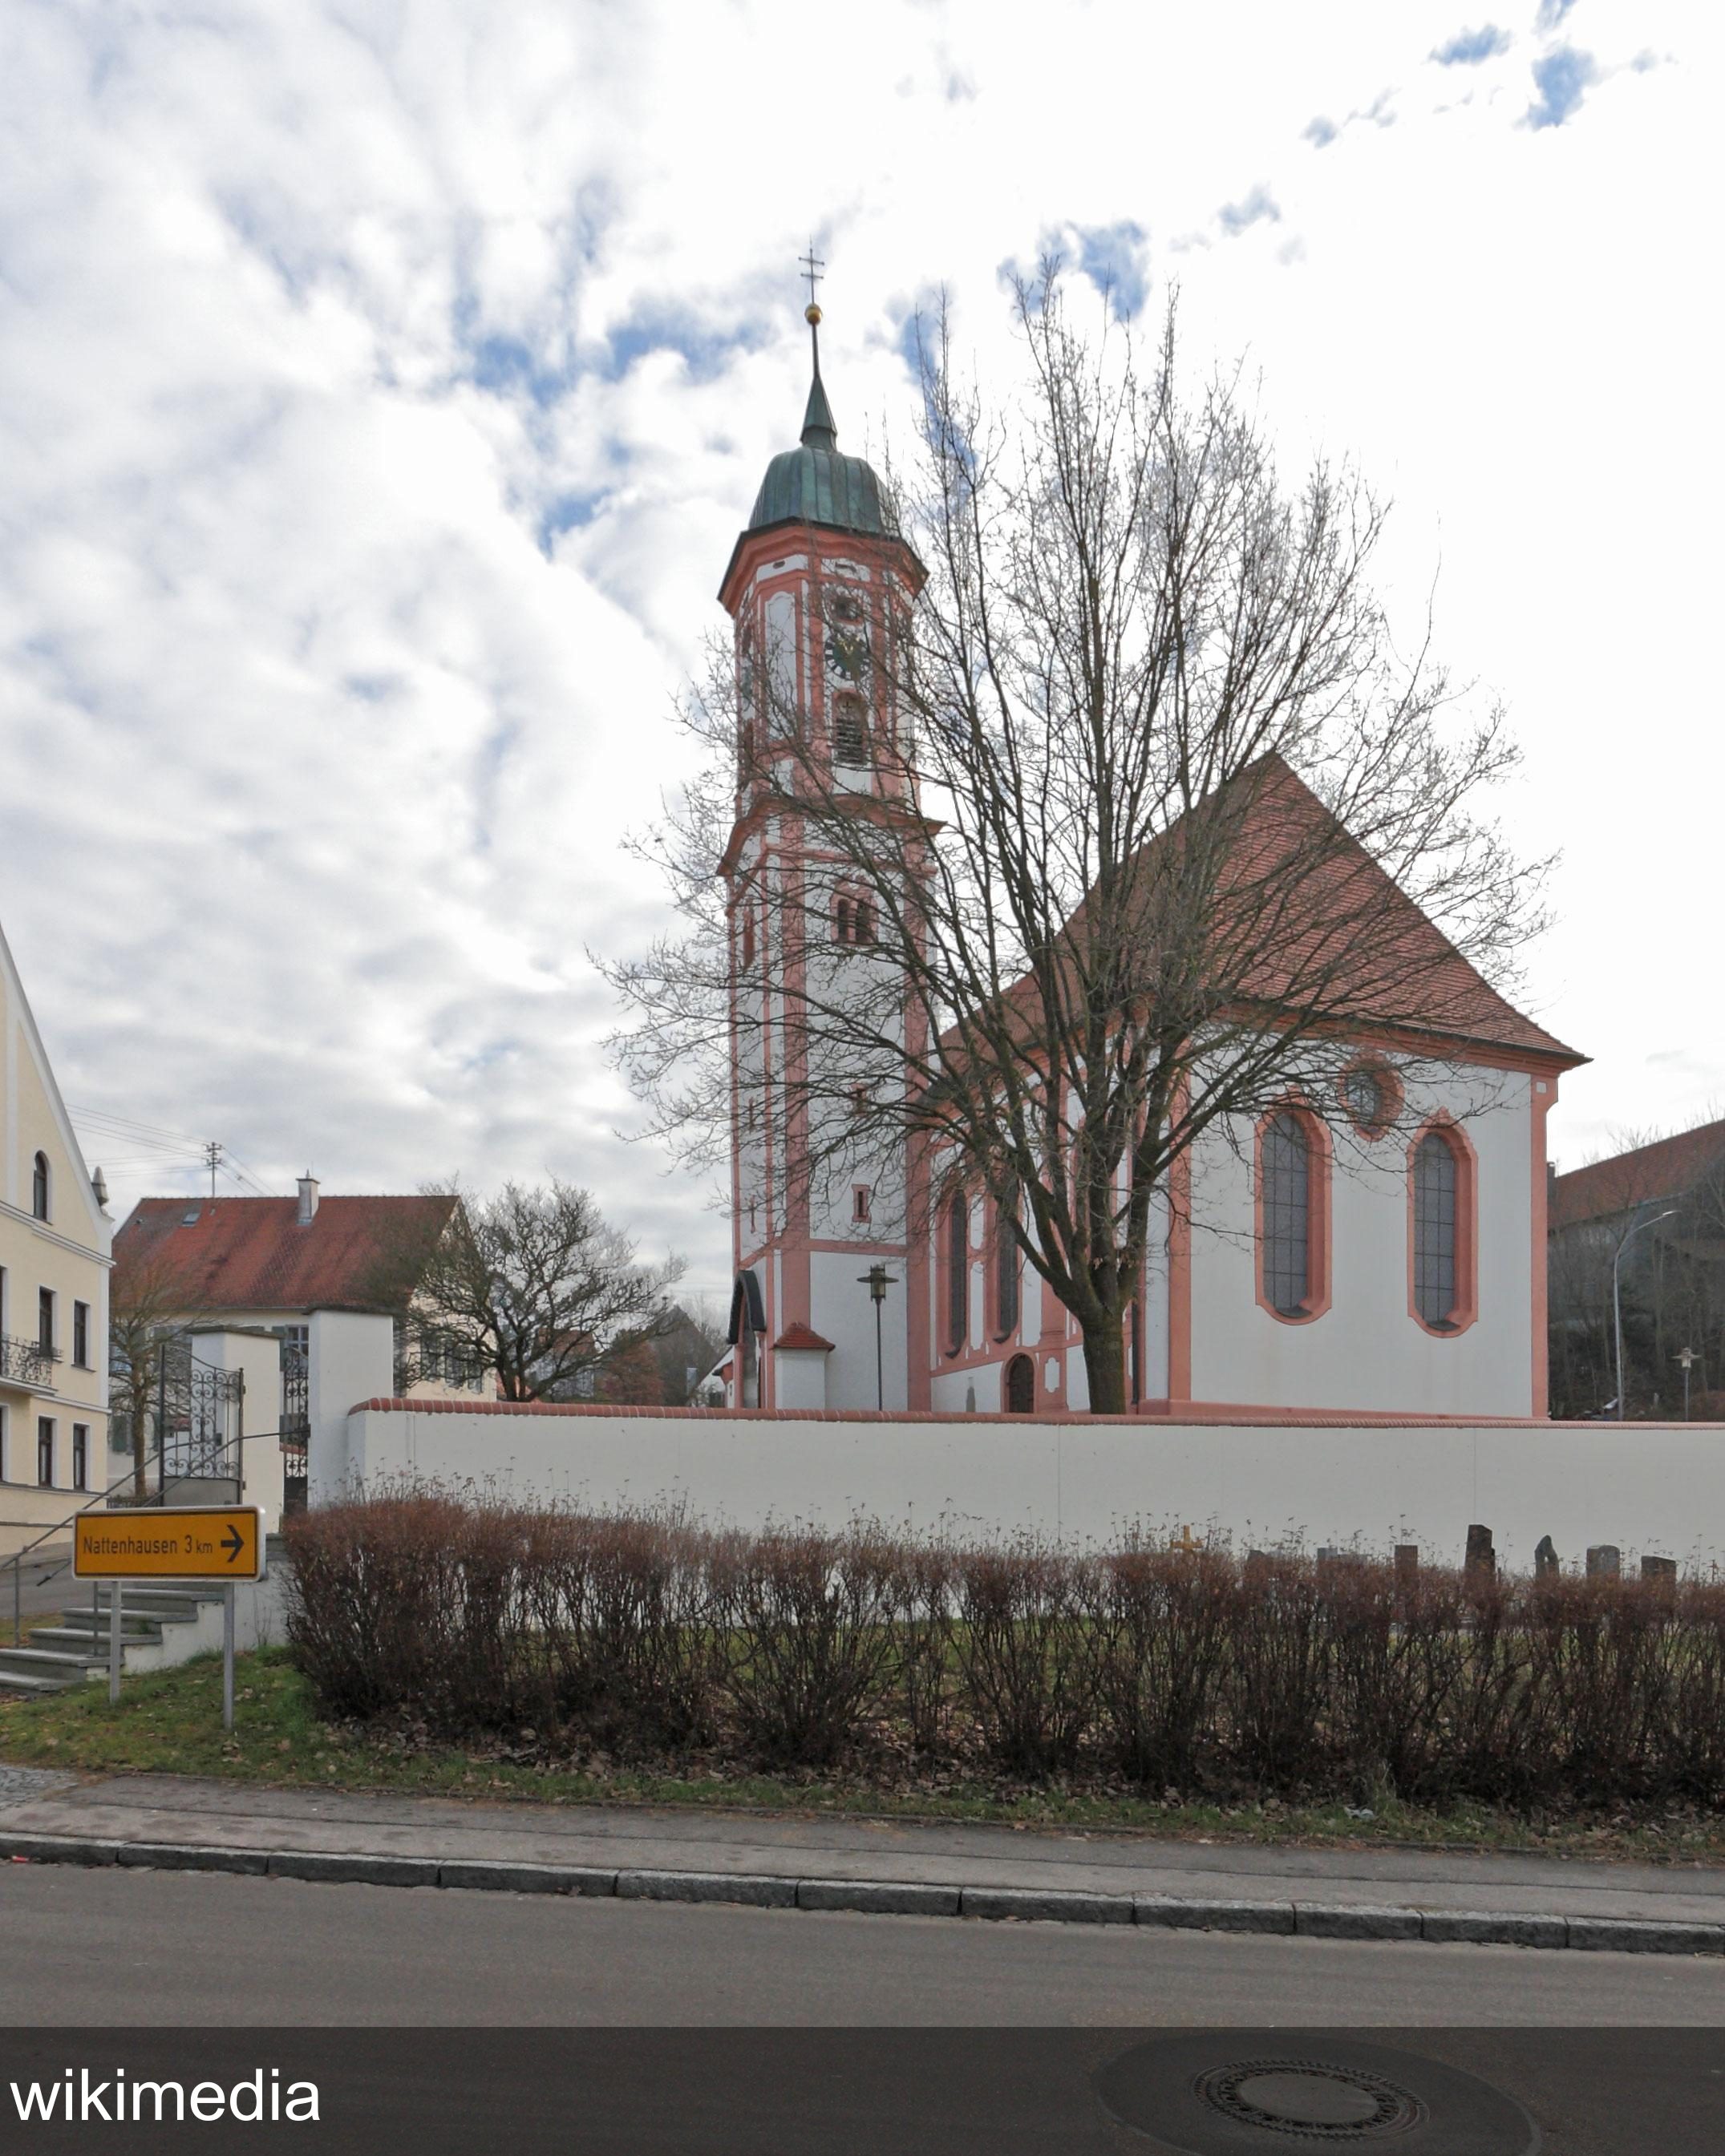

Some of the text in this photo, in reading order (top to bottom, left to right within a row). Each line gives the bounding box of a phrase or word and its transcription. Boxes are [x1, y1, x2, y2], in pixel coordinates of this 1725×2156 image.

[83, 1535, 213, 1554] Nattenhausen 3 km
